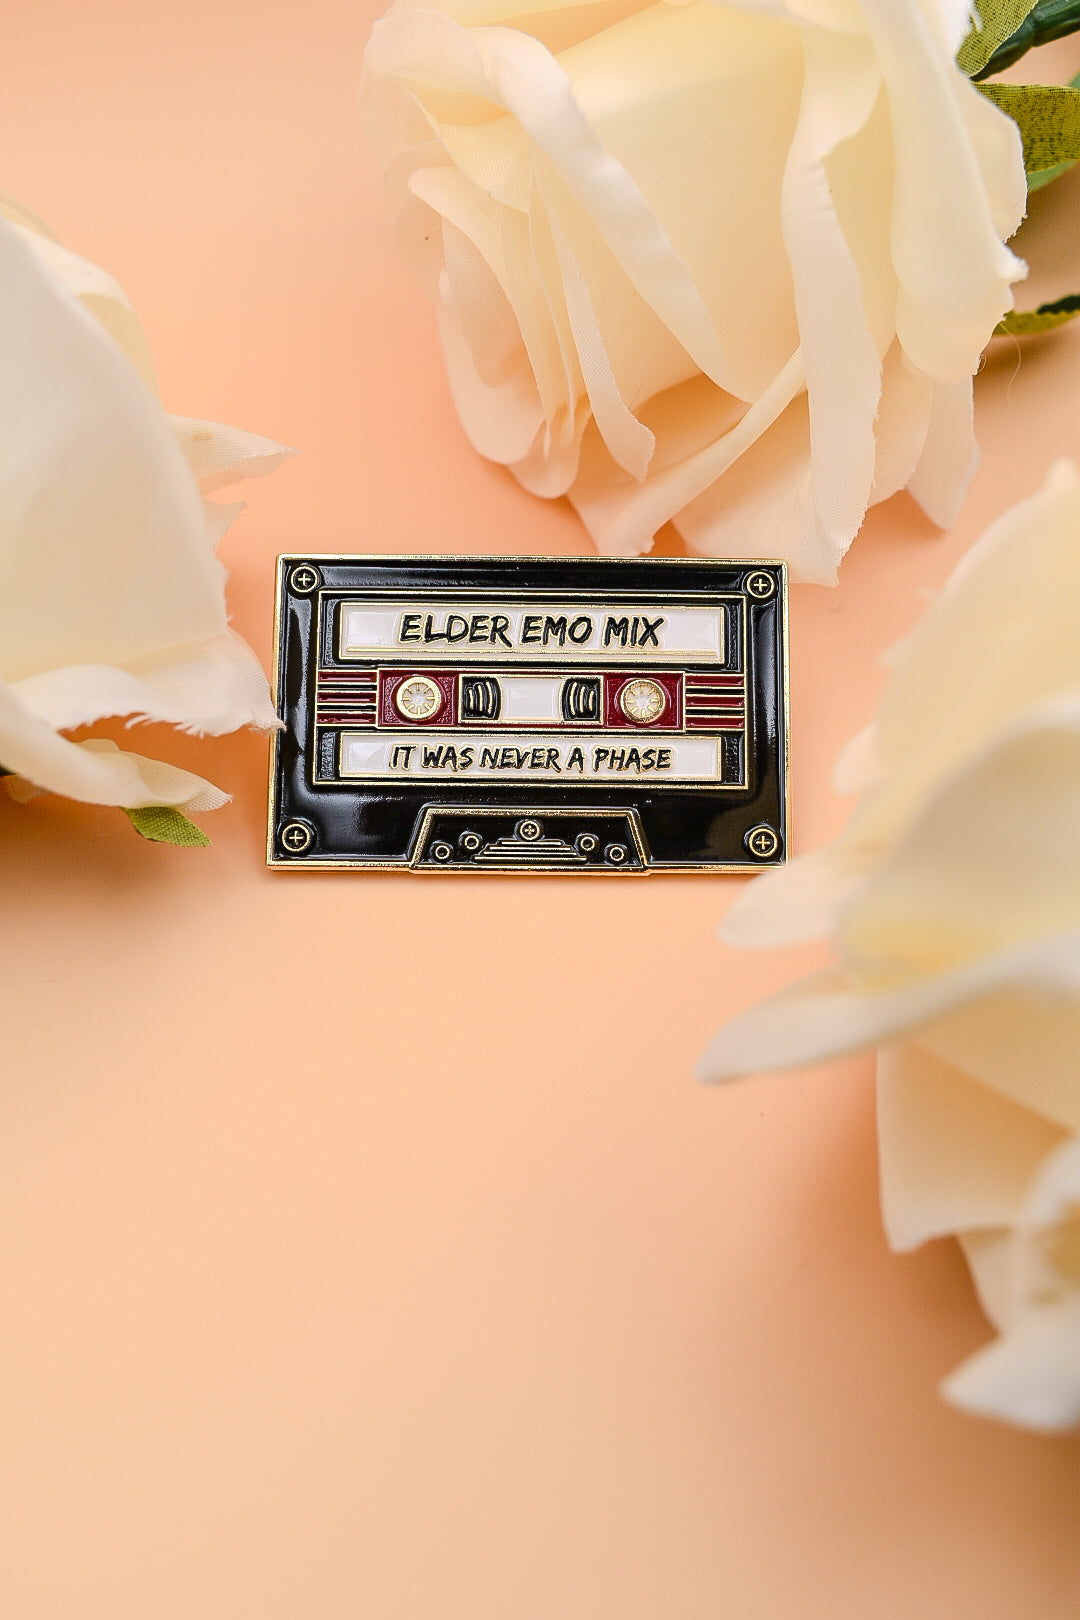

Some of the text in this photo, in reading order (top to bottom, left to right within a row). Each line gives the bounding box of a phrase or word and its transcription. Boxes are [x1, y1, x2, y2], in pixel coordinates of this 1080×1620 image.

[400, 614, 665, 648] ELDER EMO MIX
[390, 745, 673, 773] IT WAS NEVER A PHASE
